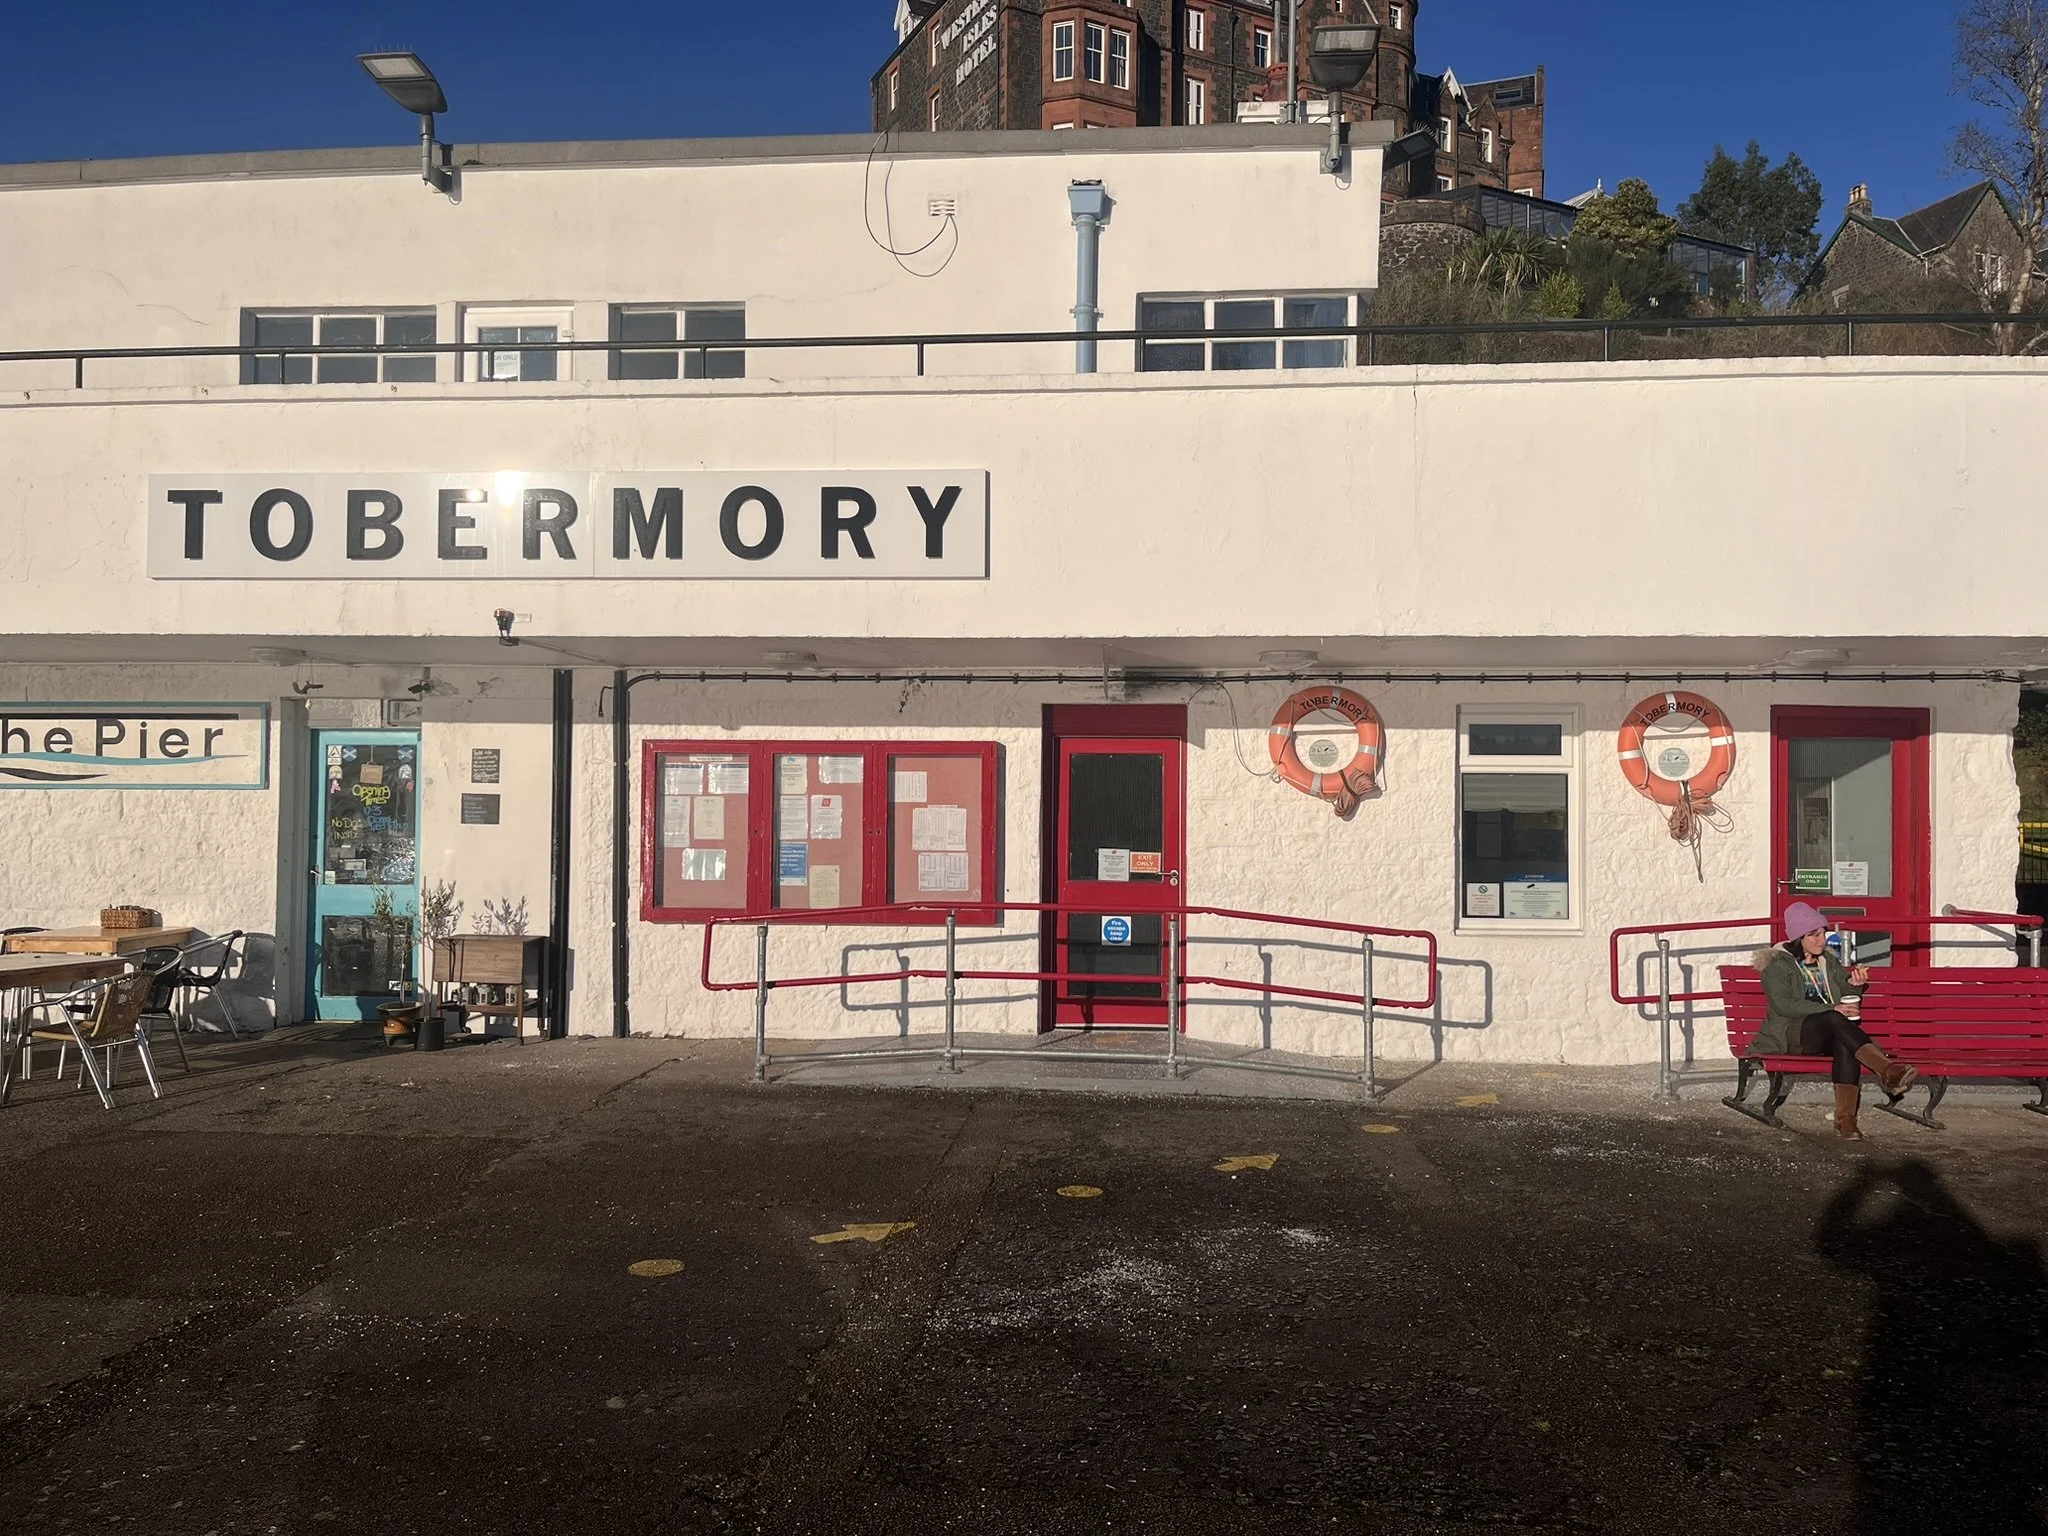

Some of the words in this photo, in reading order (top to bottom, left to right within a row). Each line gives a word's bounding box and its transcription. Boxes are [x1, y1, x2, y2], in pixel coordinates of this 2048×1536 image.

[963, 5, 997, 53] ISLES
[956, 34, 997, 87] HOTEL
[168, 486, 961, 561] TOBERMORY
[1640, 702, 1710, 726] TOBERMORY
[1, 719, 73, 754] he
[96, 719, 223, 758] Pier
[352, 784, 391, 800] Opening
